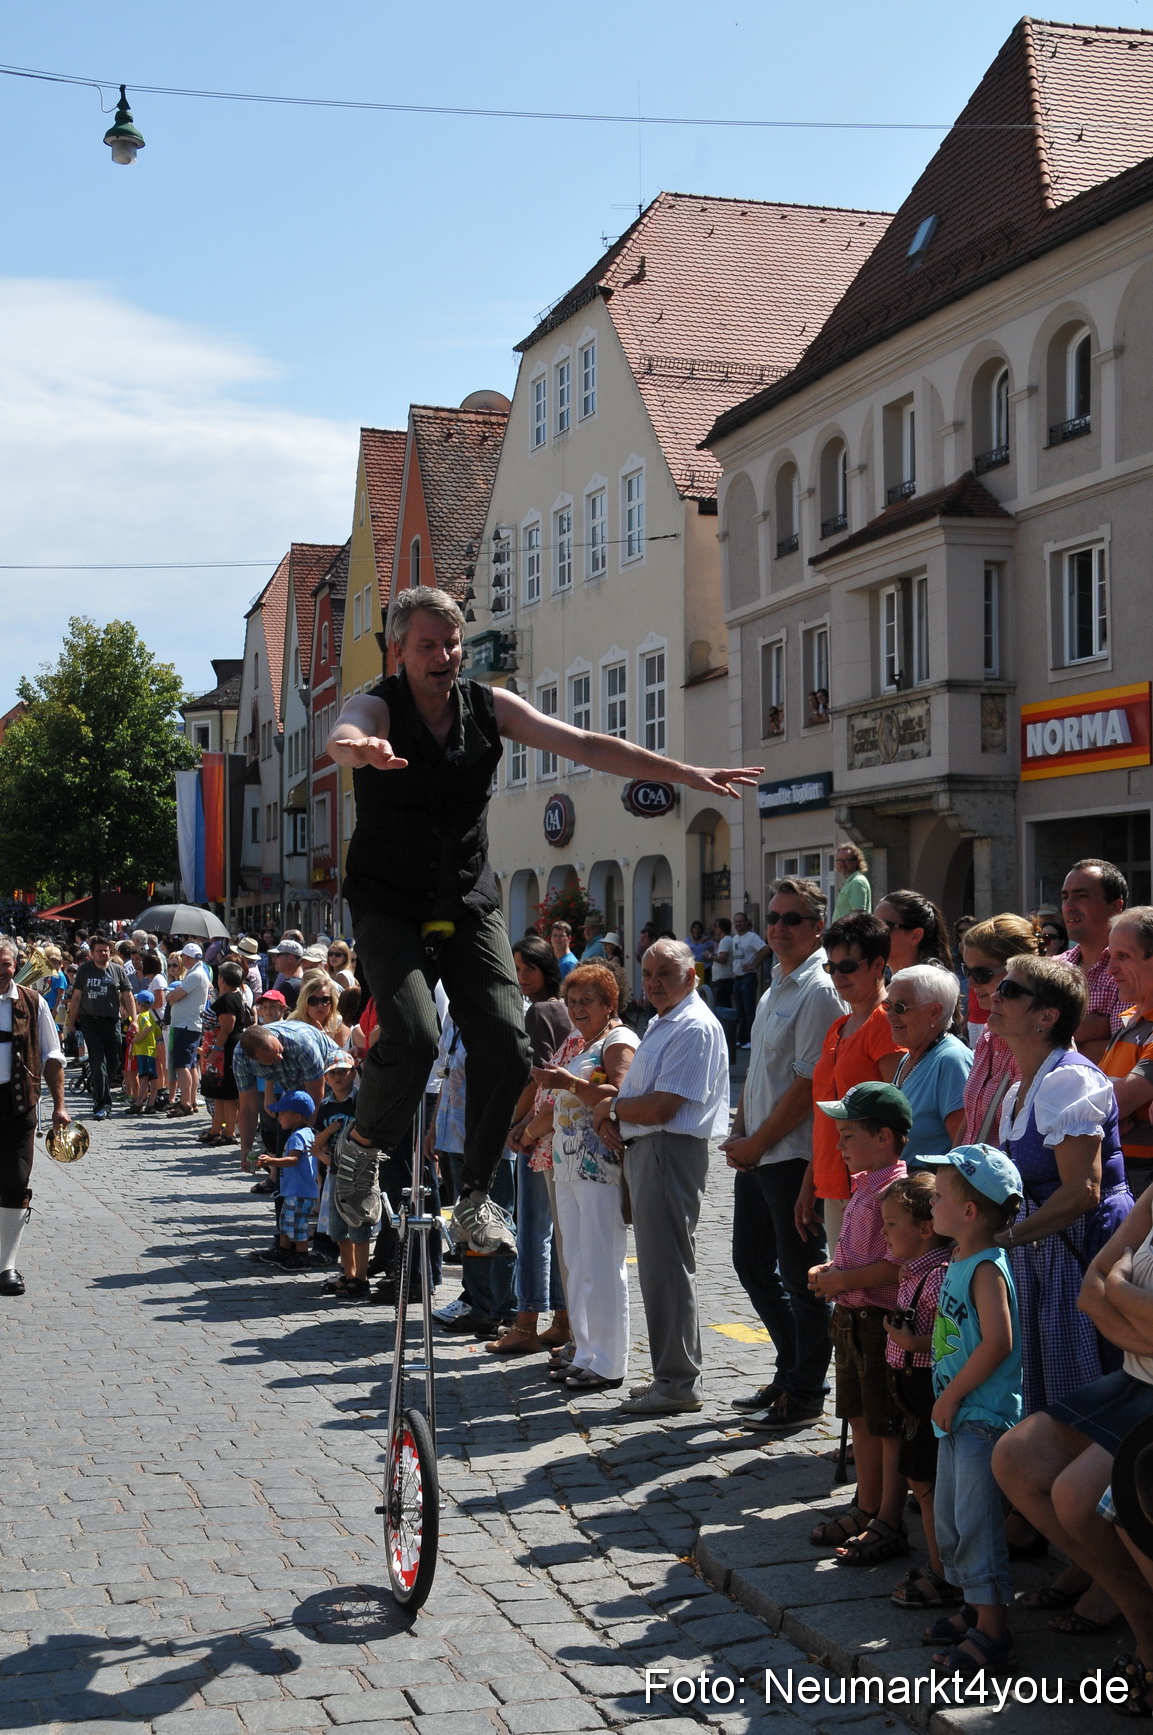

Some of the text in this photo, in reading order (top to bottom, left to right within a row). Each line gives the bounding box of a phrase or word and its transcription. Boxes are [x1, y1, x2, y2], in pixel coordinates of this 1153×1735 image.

[1026, 709, 1131, 758] NORMA
[637, 787, 668, 805] C&A
[545, 808, 561, 832] C&A
[86, 977, 102, 987] PIER
[100, 985, 108, 993] 39
[960, 1160, 977, 1176] 28
